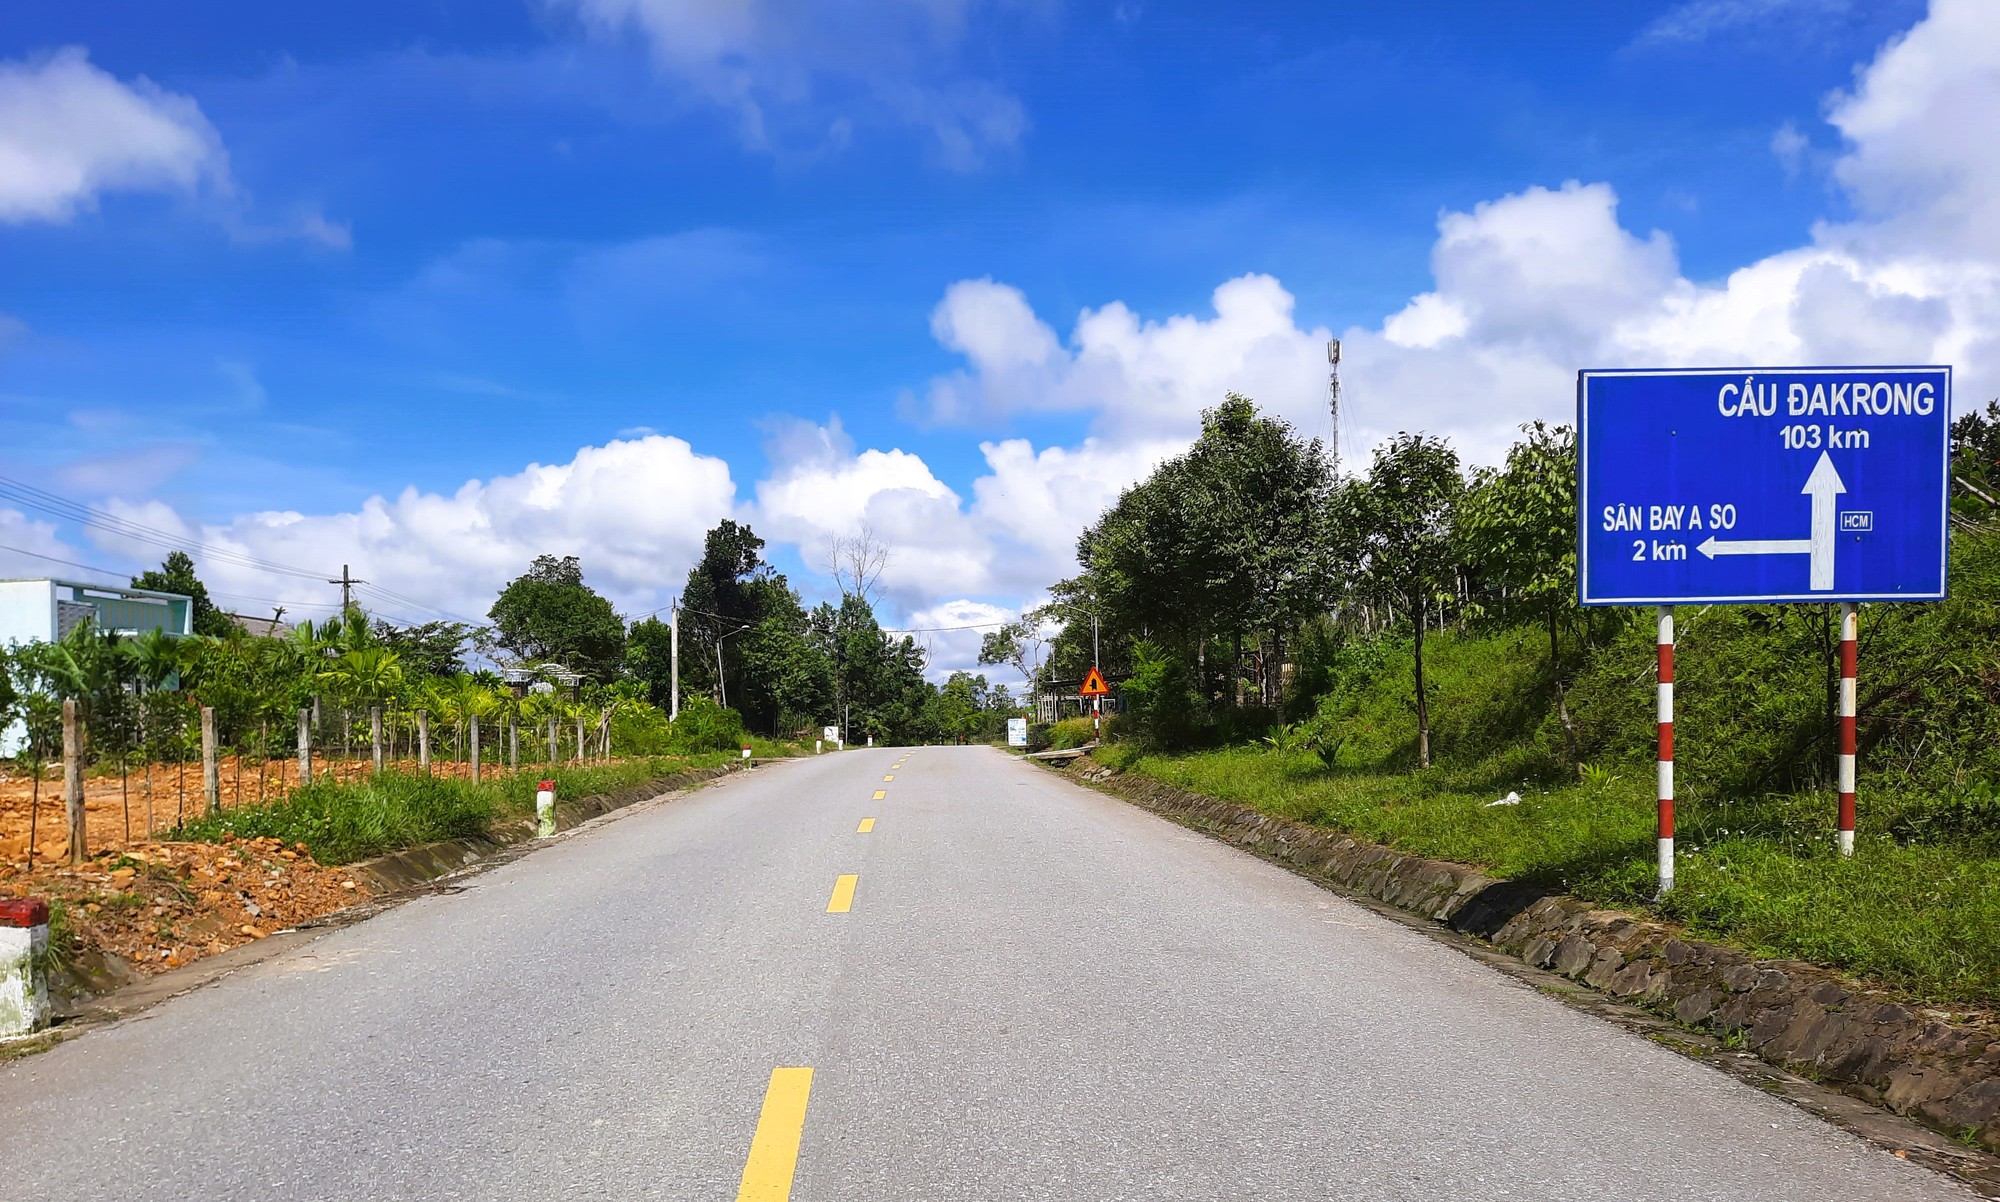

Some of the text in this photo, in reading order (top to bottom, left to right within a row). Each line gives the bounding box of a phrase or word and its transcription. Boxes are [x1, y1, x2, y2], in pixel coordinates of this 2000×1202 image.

[1787, 382, 1935, 416] ĐAKRONG
[1780, 424, 1870, 450] 103 km
[1603, 502, 1737, 532] SÂN BAY A SO
[1844, 514, 1869, 528] HCM
[1632, 539, 1687, 561] 2 km
